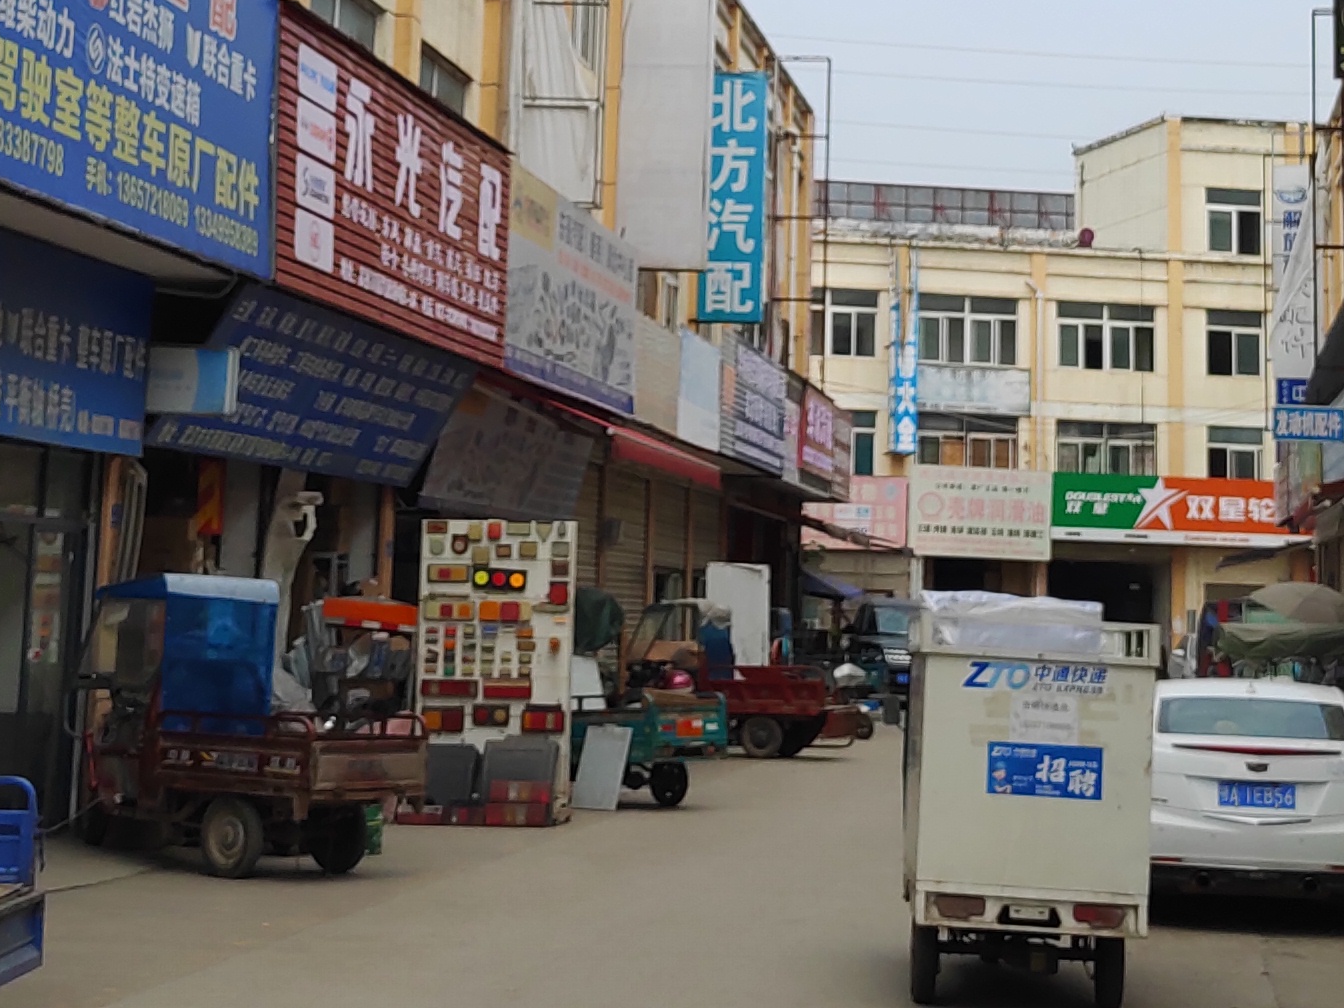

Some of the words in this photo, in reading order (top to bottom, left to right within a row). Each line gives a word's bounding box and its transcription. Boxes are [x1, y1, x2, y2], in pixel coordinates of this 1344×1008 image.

[106, 34, 202, 128] 法士特变速箱
[201, 33, 257, 103] 联合重卡
[344, 77, 503, 262] 永光汽配
[702, 80, 758, 316] 北方汽配
[1275, 410, 1343, 439] 发动机配件
[961, 661, 1031, 690] ZTO
[1033, 663, 1109, 685] 中通快递
[1034, 754, 1099, 798] 招聘
